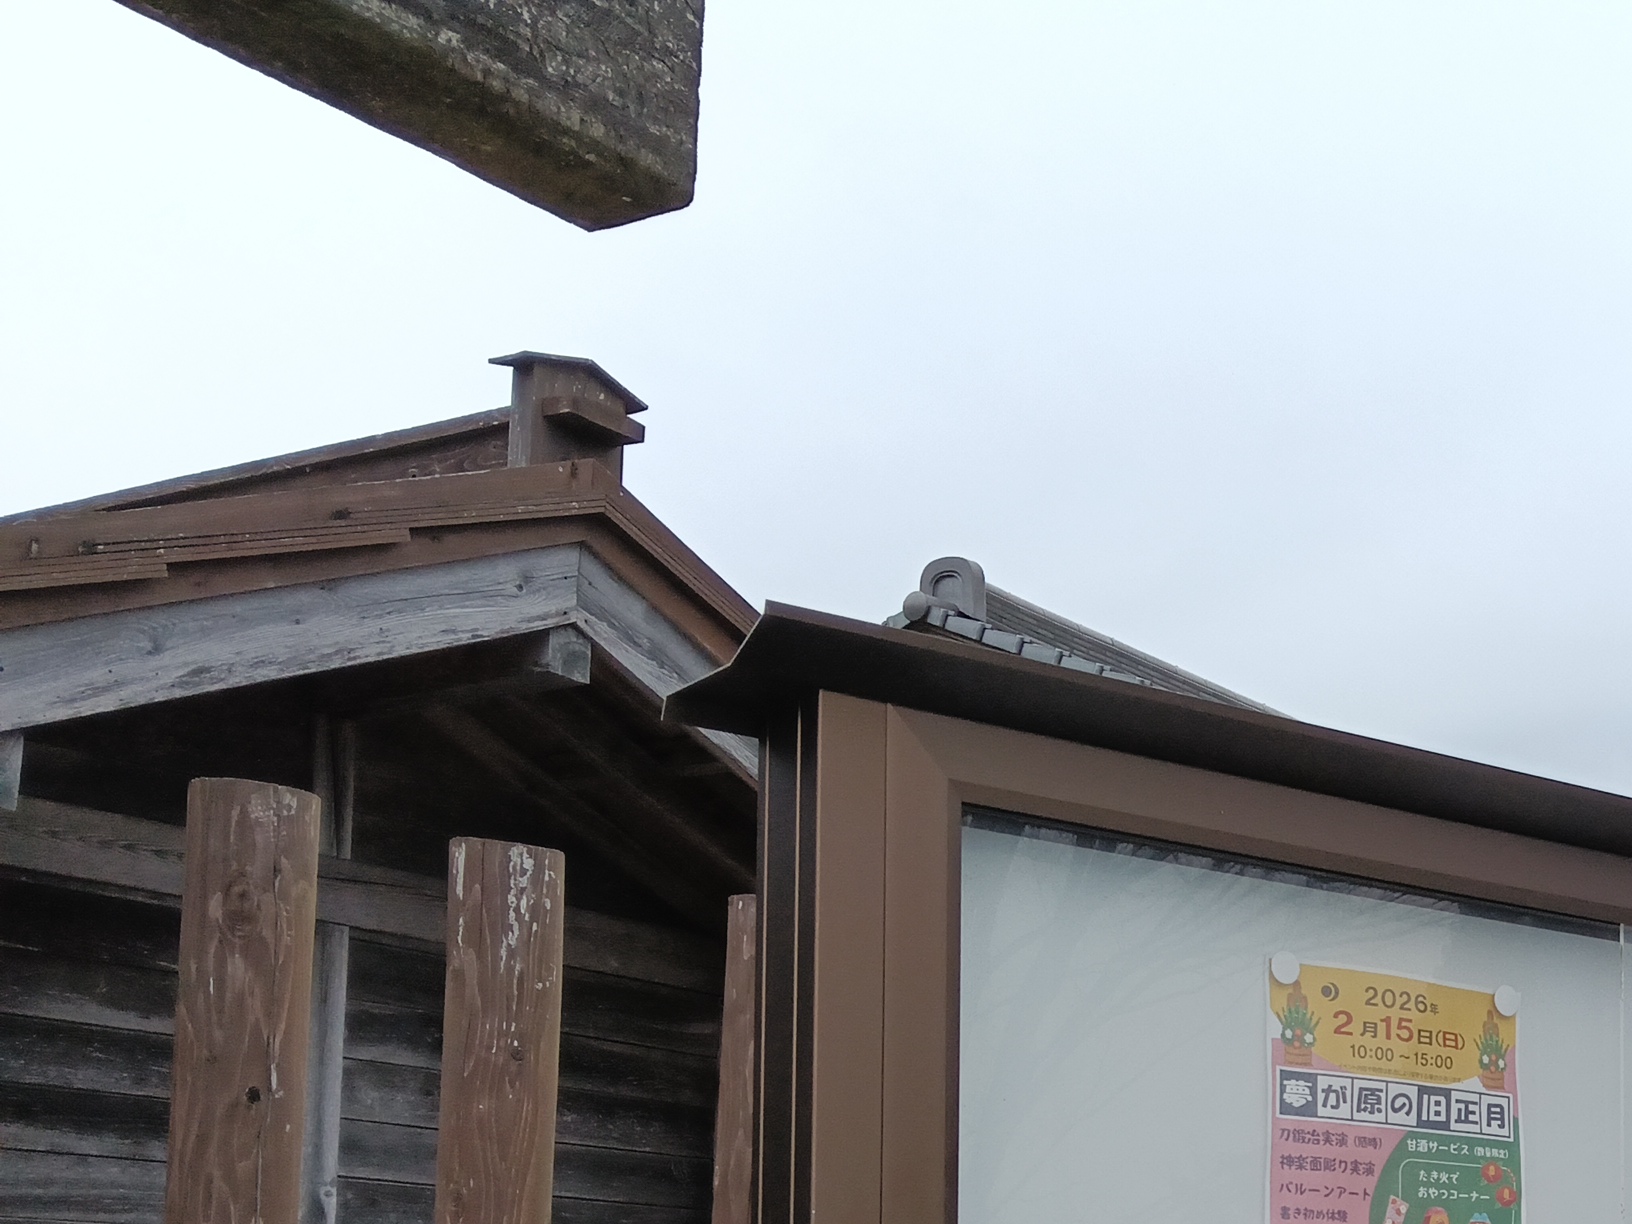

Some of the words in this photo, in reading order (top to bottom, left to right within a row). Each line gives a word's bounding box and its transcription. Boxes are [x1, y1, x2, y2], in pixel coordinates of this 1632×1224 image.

[1364, 986, 1440, 1015] 2026年
[1333, 1010, 1466, 1050] 2月15日(日)
[1282, 1079, 1506, 1130] 夢が原の旧正月
[1419, 1169, 1460, 1184] たき火で
[1278, 1181, 1372, 1202] バルーンアート
[1418, 1187, 1490, 1202] おやつコーナー
